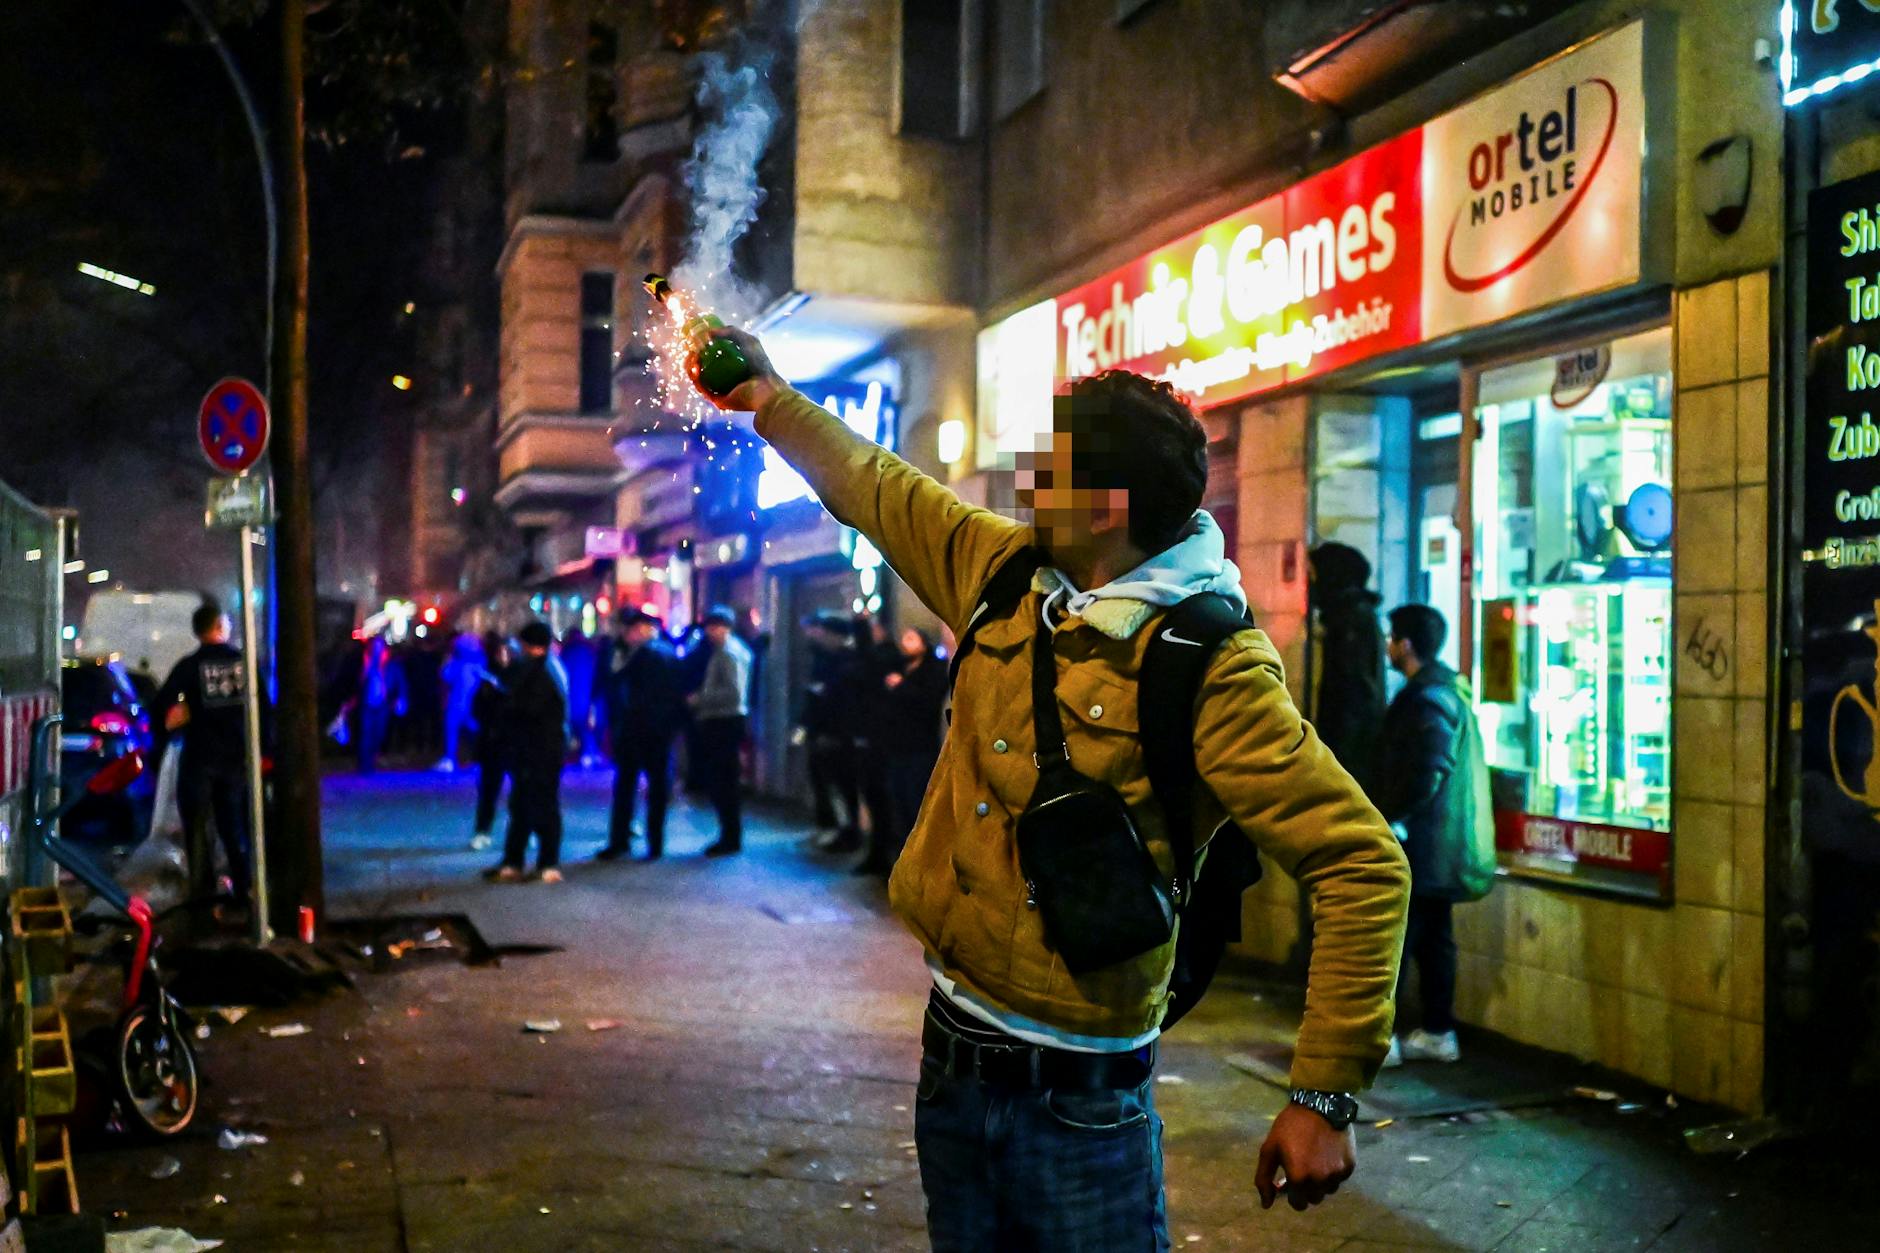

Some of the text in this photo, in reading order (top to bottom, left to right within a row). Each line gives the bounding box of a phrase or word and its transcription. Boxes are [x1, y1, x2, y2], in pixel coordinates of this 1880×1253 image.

[1469, 85, 1576, 191] ortel
[1471, 161, 1576, 227] MOBILE
[1062, 262, 1188, 379] Technic
[1227, 191, 1397, 324] Games
[1845, 271, 1880, 324] Ta
